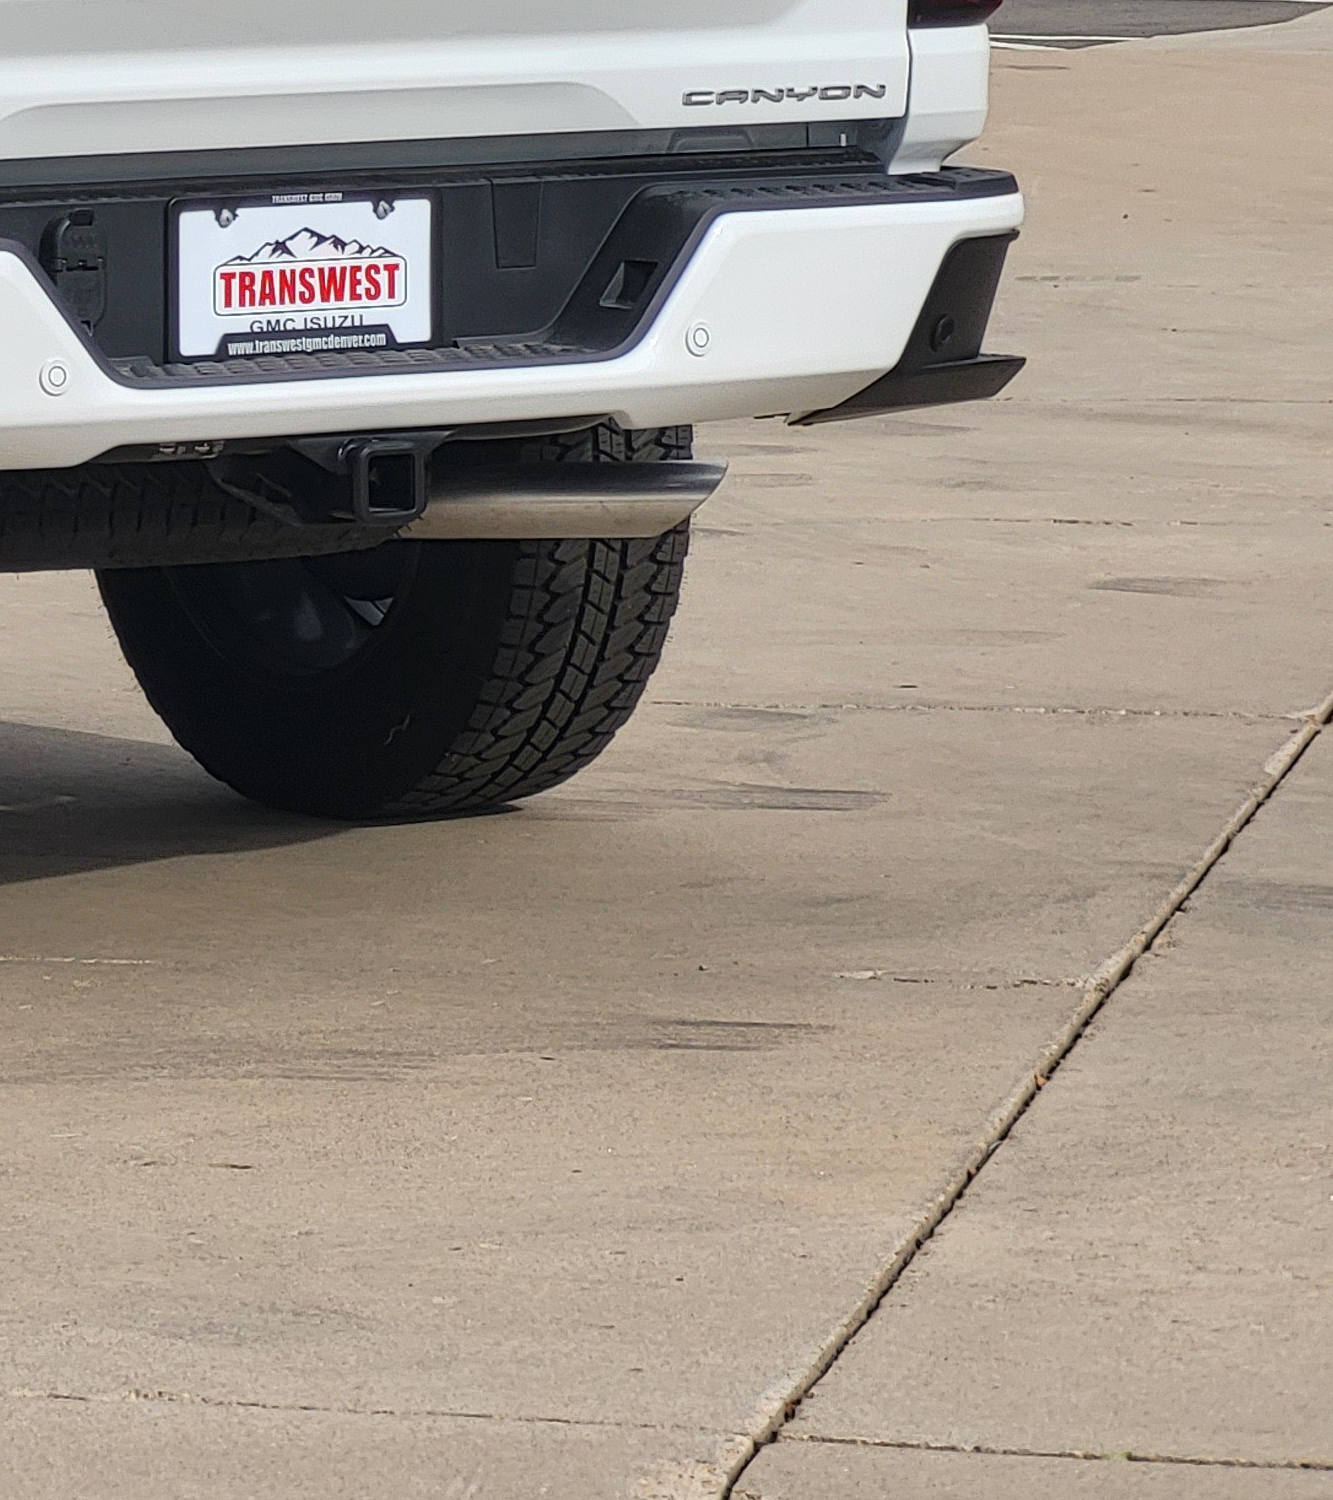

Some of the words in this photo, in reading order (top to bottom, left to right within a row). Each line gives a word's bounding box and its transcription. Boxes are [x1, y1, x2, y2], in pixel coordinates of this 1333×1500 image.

[682, 84, 886, 106] CANYON
[220, 263, 400, 309] TRANSWEST
[250, 318, 296, 333] GMC
[303, 314, 364, 330] ISUZU
[228, 333, 387, 356] www.transwestgmcdenver.com
